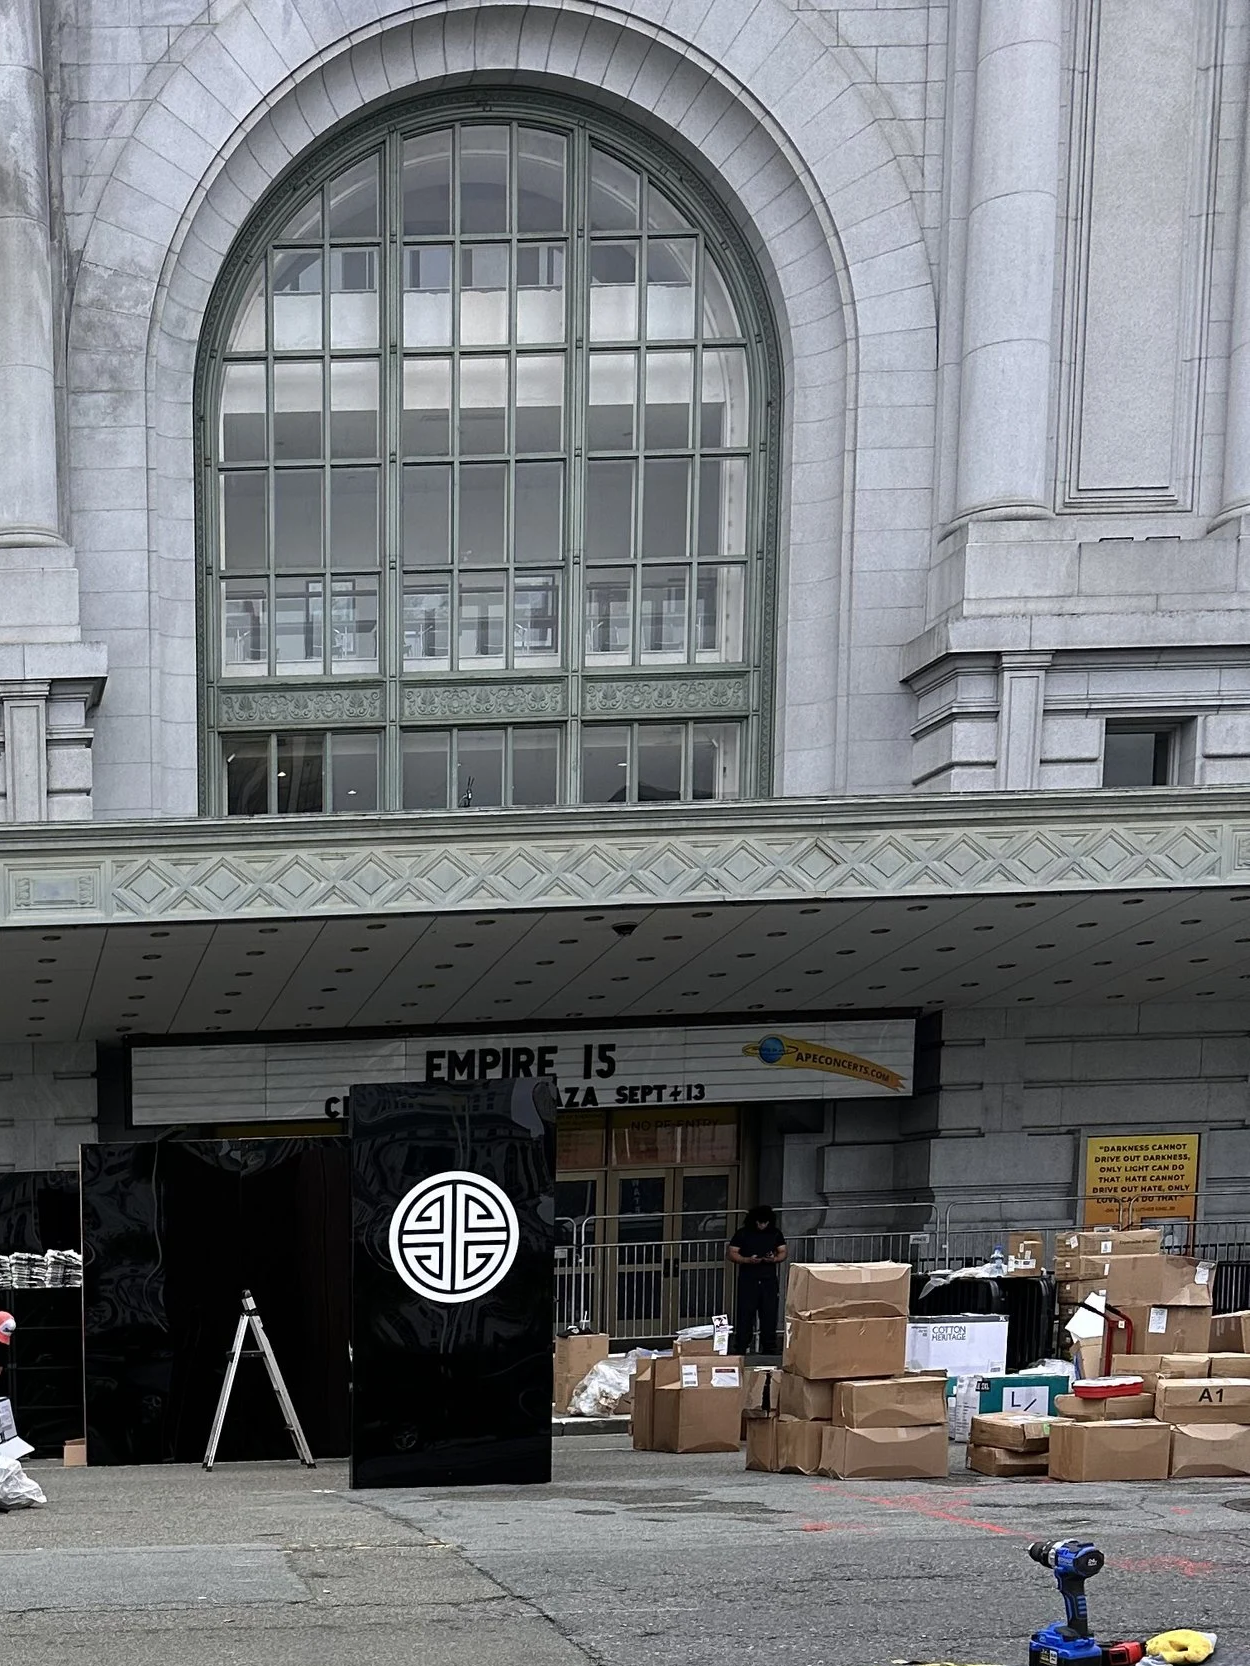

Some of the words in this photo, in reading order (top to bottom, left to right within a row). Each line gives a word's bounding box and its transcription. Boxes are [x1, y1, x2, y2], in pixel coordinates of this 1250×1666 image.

[425, 1045, 559, 1081] EMPIRE
[583, 1043, 617, 1079] 15
[795, 1052, 891, 1082] APECONCERTS.COM
[615, 1084, 667, 1104] SEPT
[686, 1083, 705, 1101] 13
[631, 1120, 652, 1131] NO
[1094, 1155, 1121, 1163] DRIVE
[1143, 1154, 1191, 1162] DARKNESS,
[932, 1325, 966, 1334] COTTON
[931, 1333, 966, 1341] HERITAGE
[1198, 1388, 1225, 1403] A1
